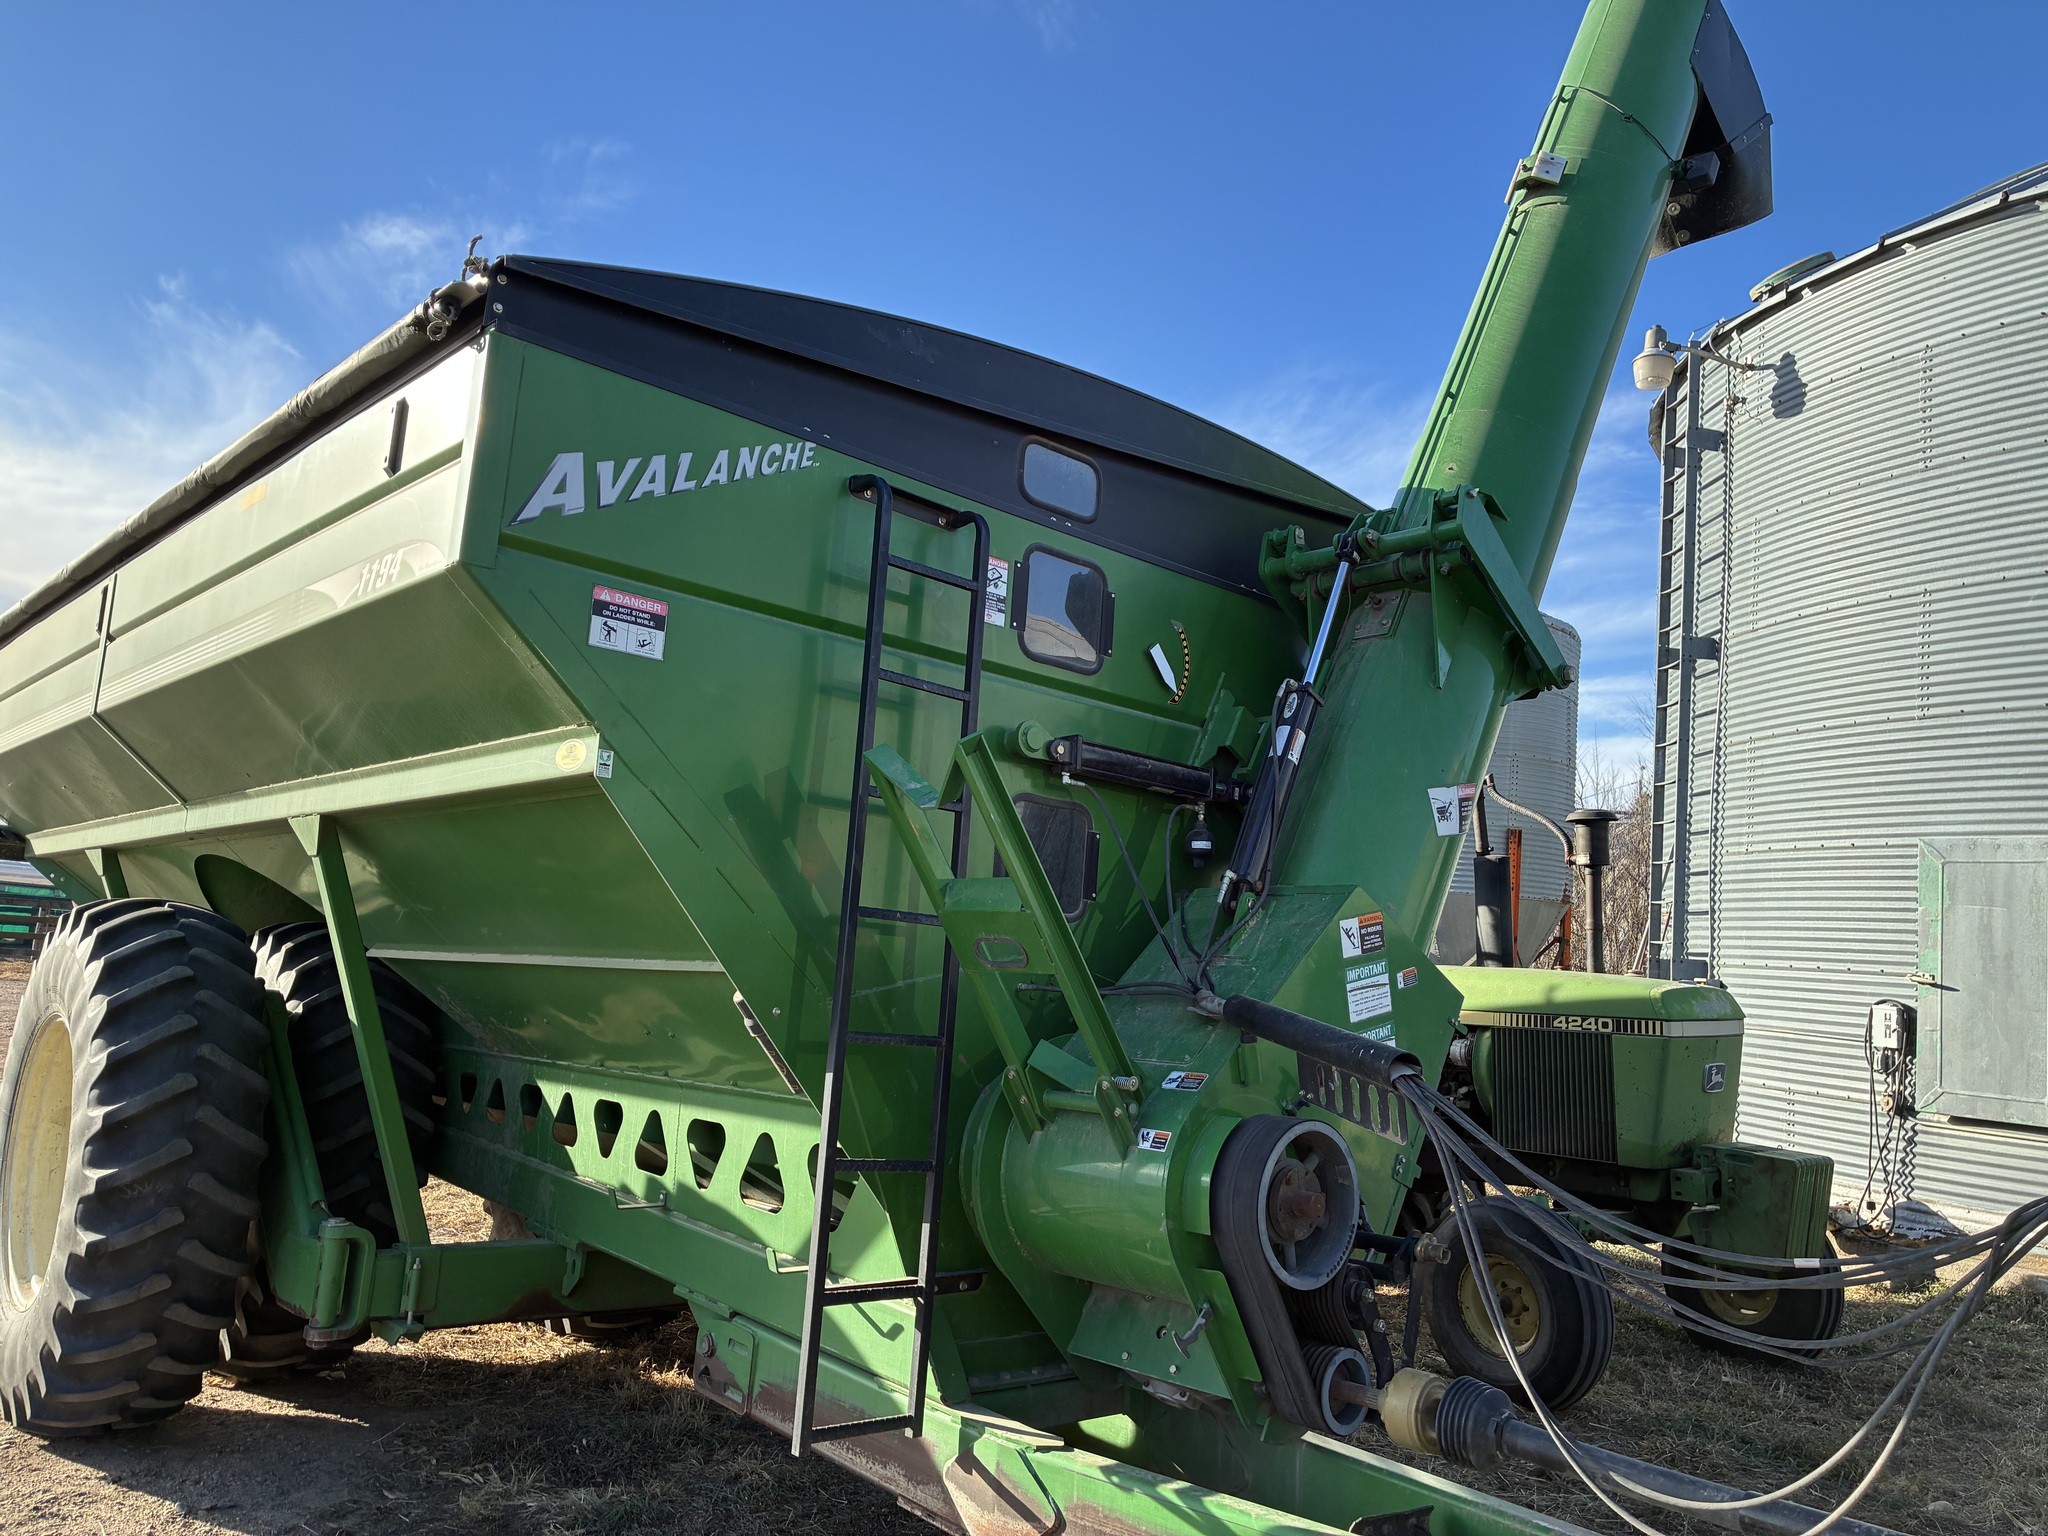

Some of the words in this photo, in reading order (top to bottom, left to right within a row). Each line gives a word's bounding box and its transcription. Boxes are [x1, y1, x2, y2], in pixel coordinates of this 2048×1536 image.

[507, 442, 817, 527] AVALANCHE
[357, 547, 404, 597] 1194
[989, 558, 1008, 569] ANGER
[615, 593, 662, 612] DANGER
[612, 611, 636, 622] LADDER
[637, 617, 656, 627] WHILE:
[619, 606, 631, 615] NOT
[632, 610, 651, 619] STAND
[1367, 925, 1382, 933] RIDERS
[1347, 962, 1386, 982] IMPORTANT
[1554, 1016, 1613, 1033] 4240
